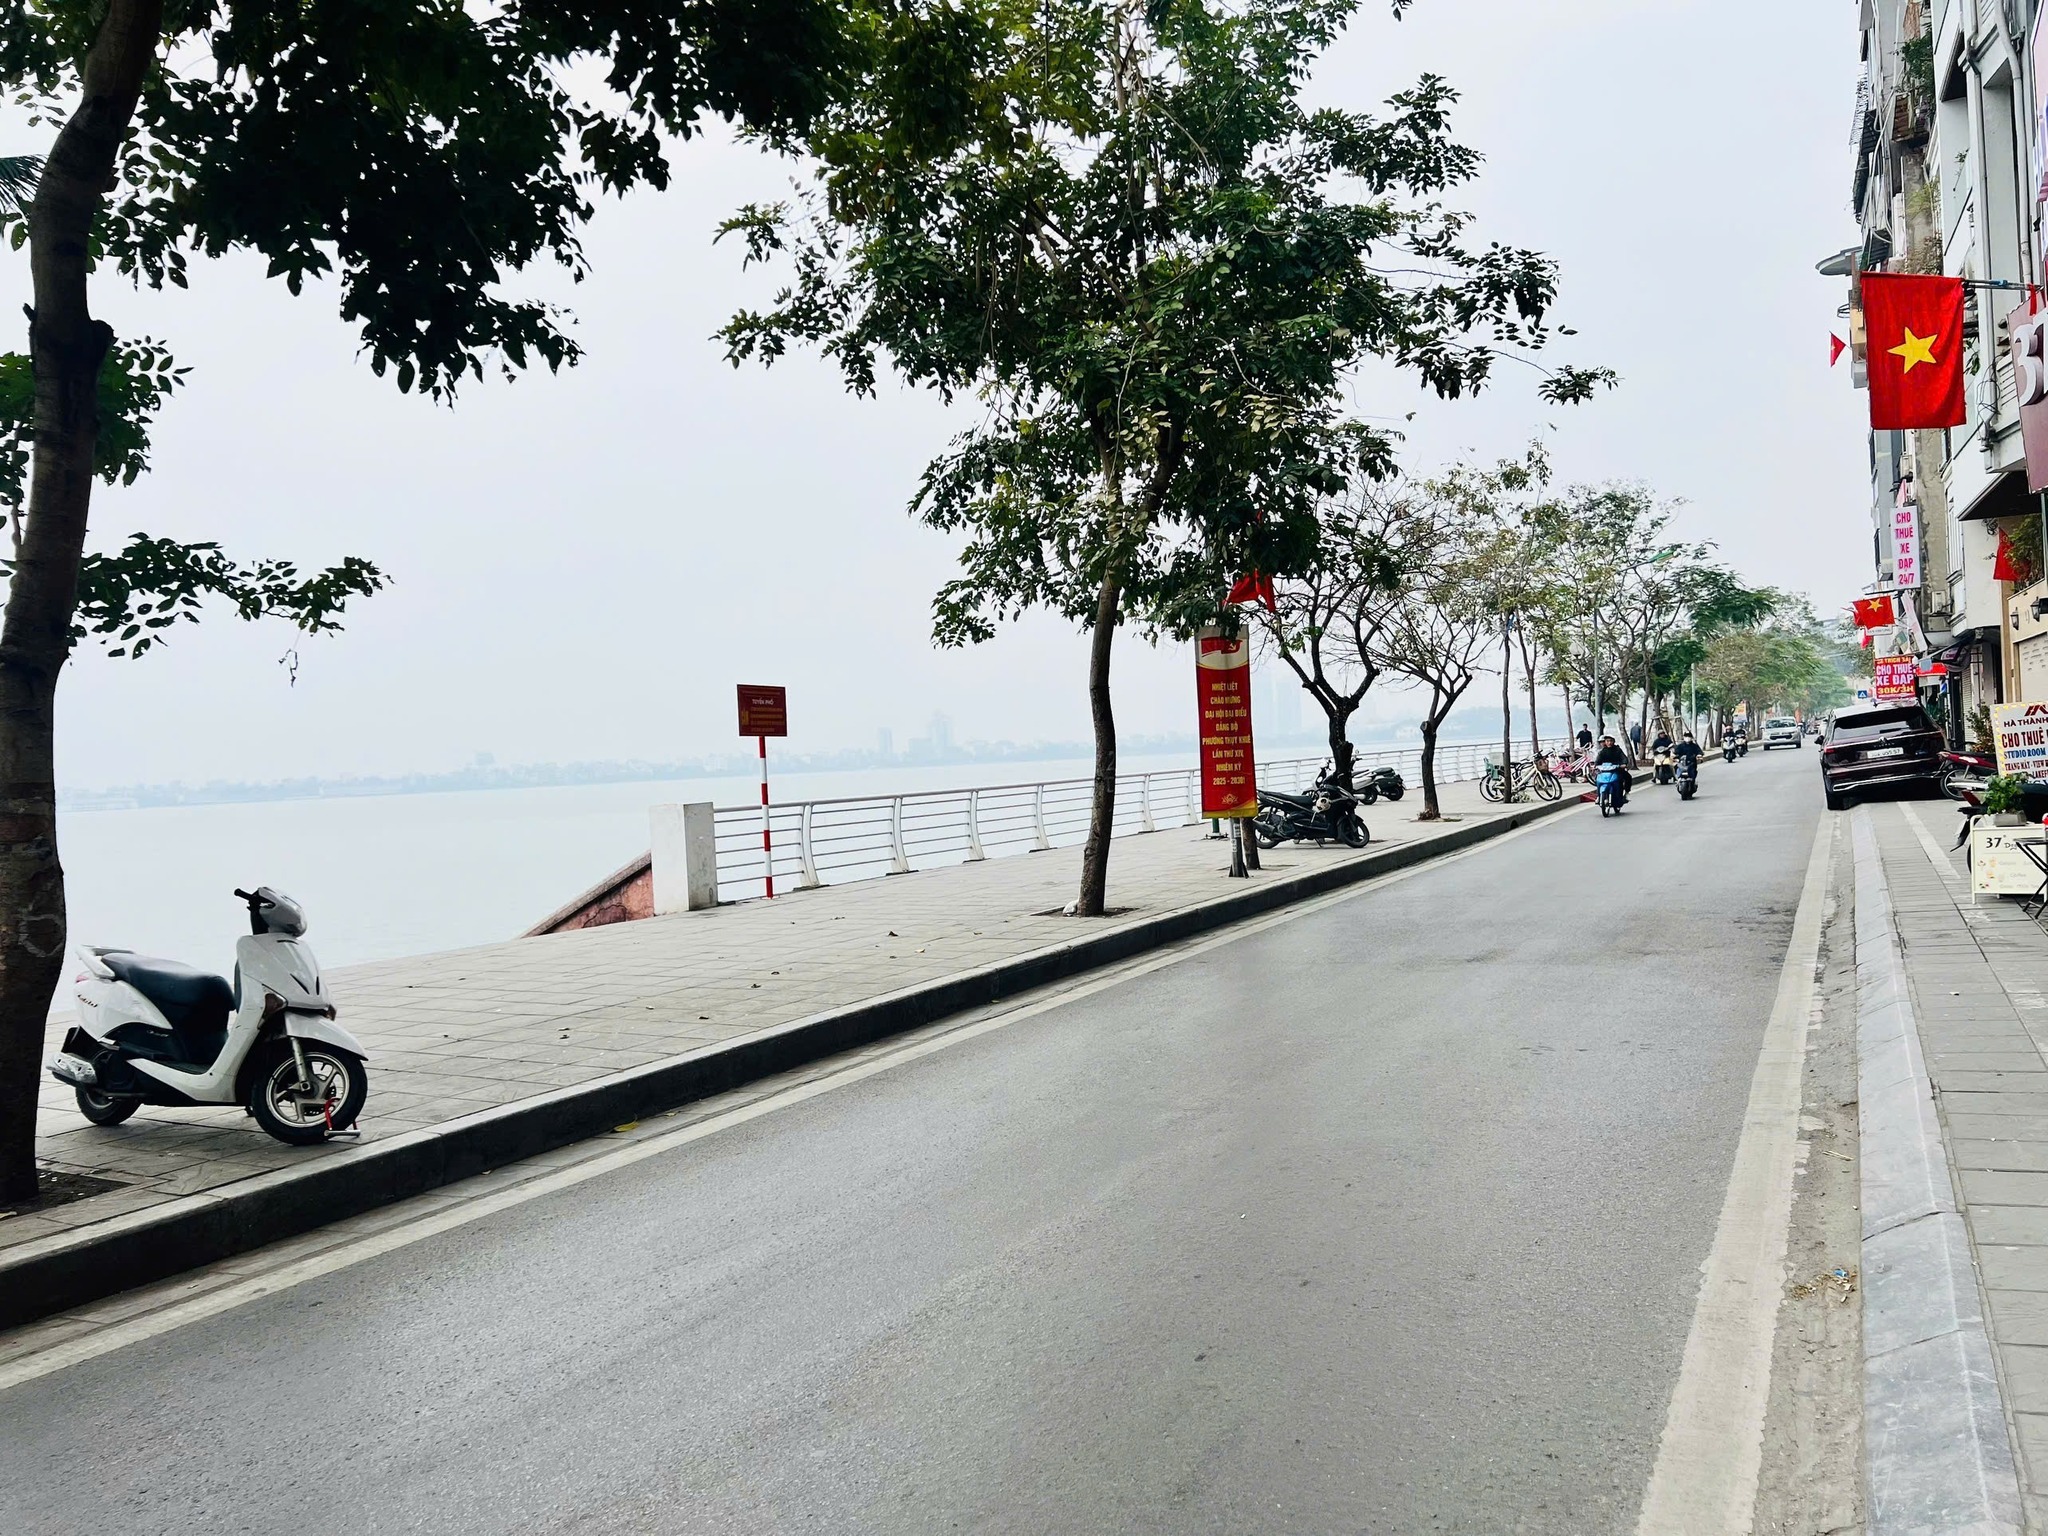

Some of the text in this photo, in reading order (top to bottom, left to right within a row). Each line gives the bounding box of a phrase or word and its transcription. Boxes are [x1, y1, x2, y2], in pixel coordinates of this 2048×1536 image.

[1896, 512, 1911, 524] CHO
[1895, 525, 1913, 540] THUÊ
[1900, 543, 1910, 554] XE
[1898, 573, 1915, 585] 24/7
[1876, 665, 1891, 675] CHO
[1876, 676, 1890, 686] XE
[2003, 719, 2016, 727] HÀ
[2001, 733, 2020, 748] CHO
[2021, 727, 2045, 746] THUÊ
[2004, 747, 2046, 759] STUDIO ROOM
[1213, 777, 1226, 785] 2025
